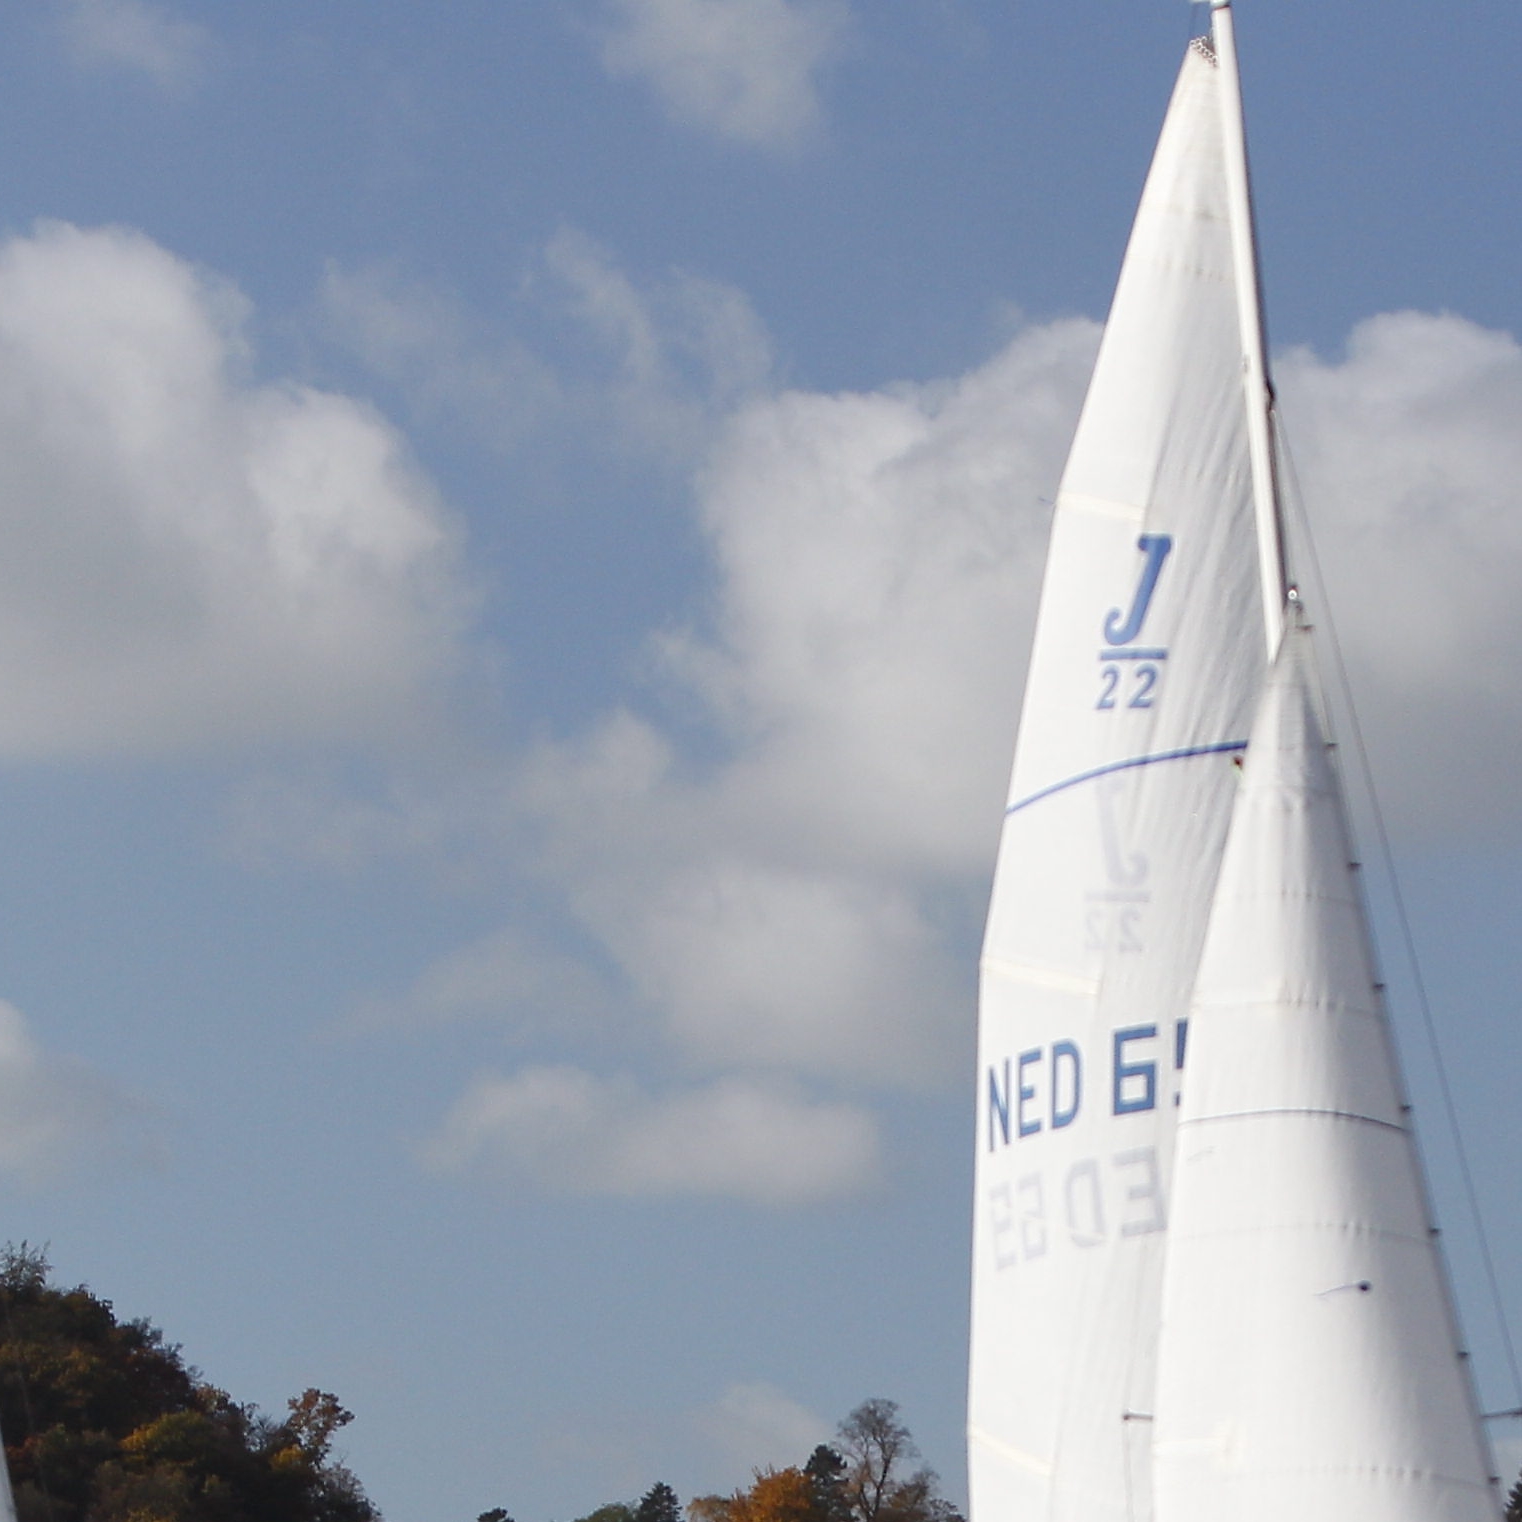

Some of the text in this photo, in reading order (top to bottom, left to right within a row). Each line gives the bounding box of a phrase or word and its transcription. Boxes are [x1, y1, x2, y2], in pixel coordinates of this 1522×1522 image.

[1104, 532, 1172, 646] J
[1095, 663, 1158, 710] 22
[988, 1037, 1082, 1152] NED
